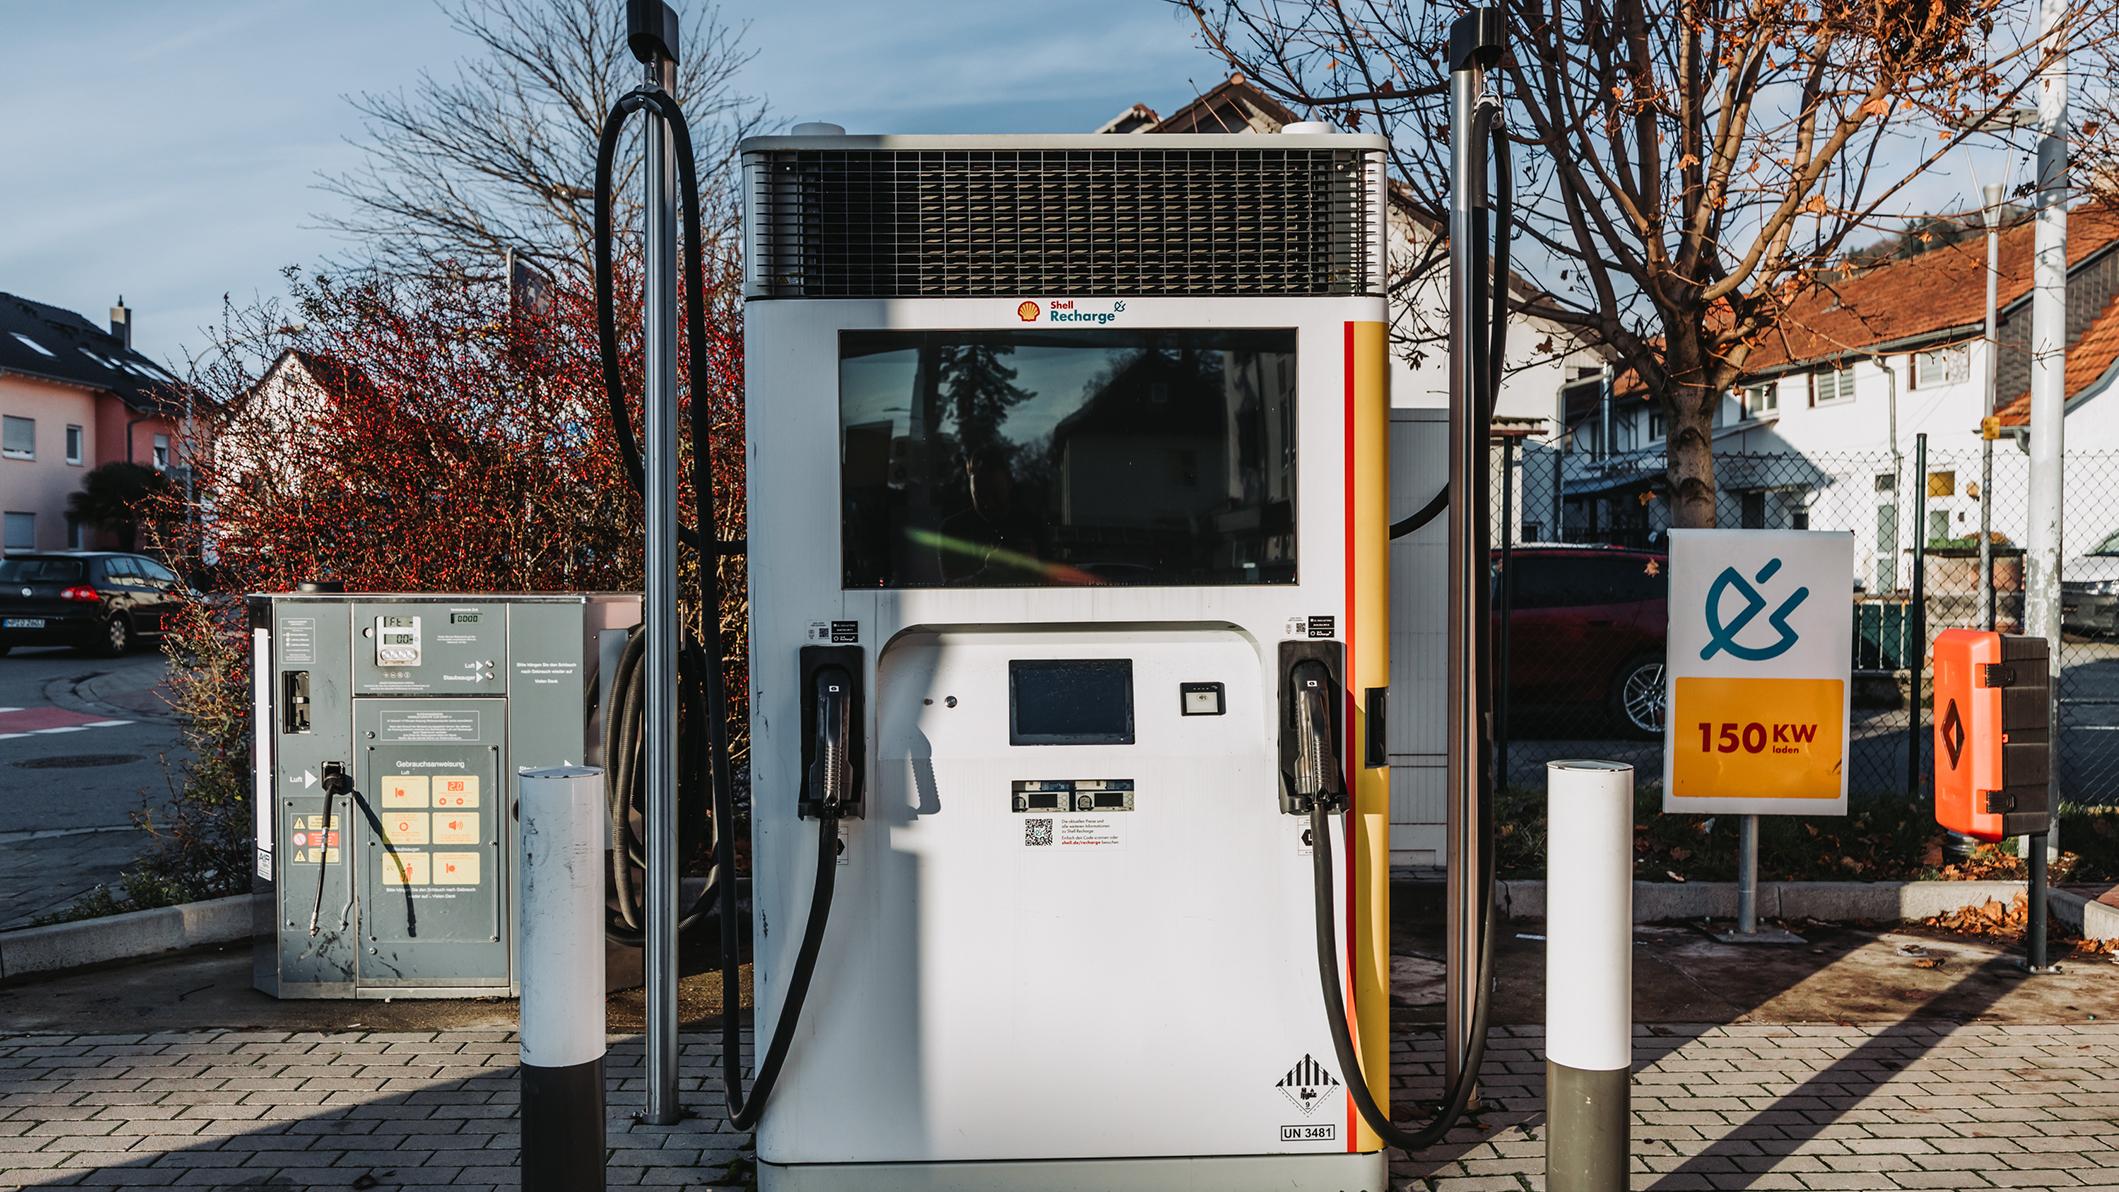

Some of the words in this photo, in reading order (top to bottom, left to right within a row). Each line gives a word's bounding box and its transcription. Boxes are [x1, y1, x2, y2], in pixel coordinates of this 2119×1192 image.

[1050, 300, 1074, 309] Shell
[1050, 309, 1115, 324] Recharge
[457, 615, 478, 623] 0000
[1698, 722, 1767, 754] 150
[1773, 724, 1818, 743] KW
[1772, 745, 1799, 754] laden
[395, 760, 465, 769] Gebrauchsanweisung
[1284, 1128, 1301, 1139] UN
[1305, 1127, 1331, 1138] 3481
